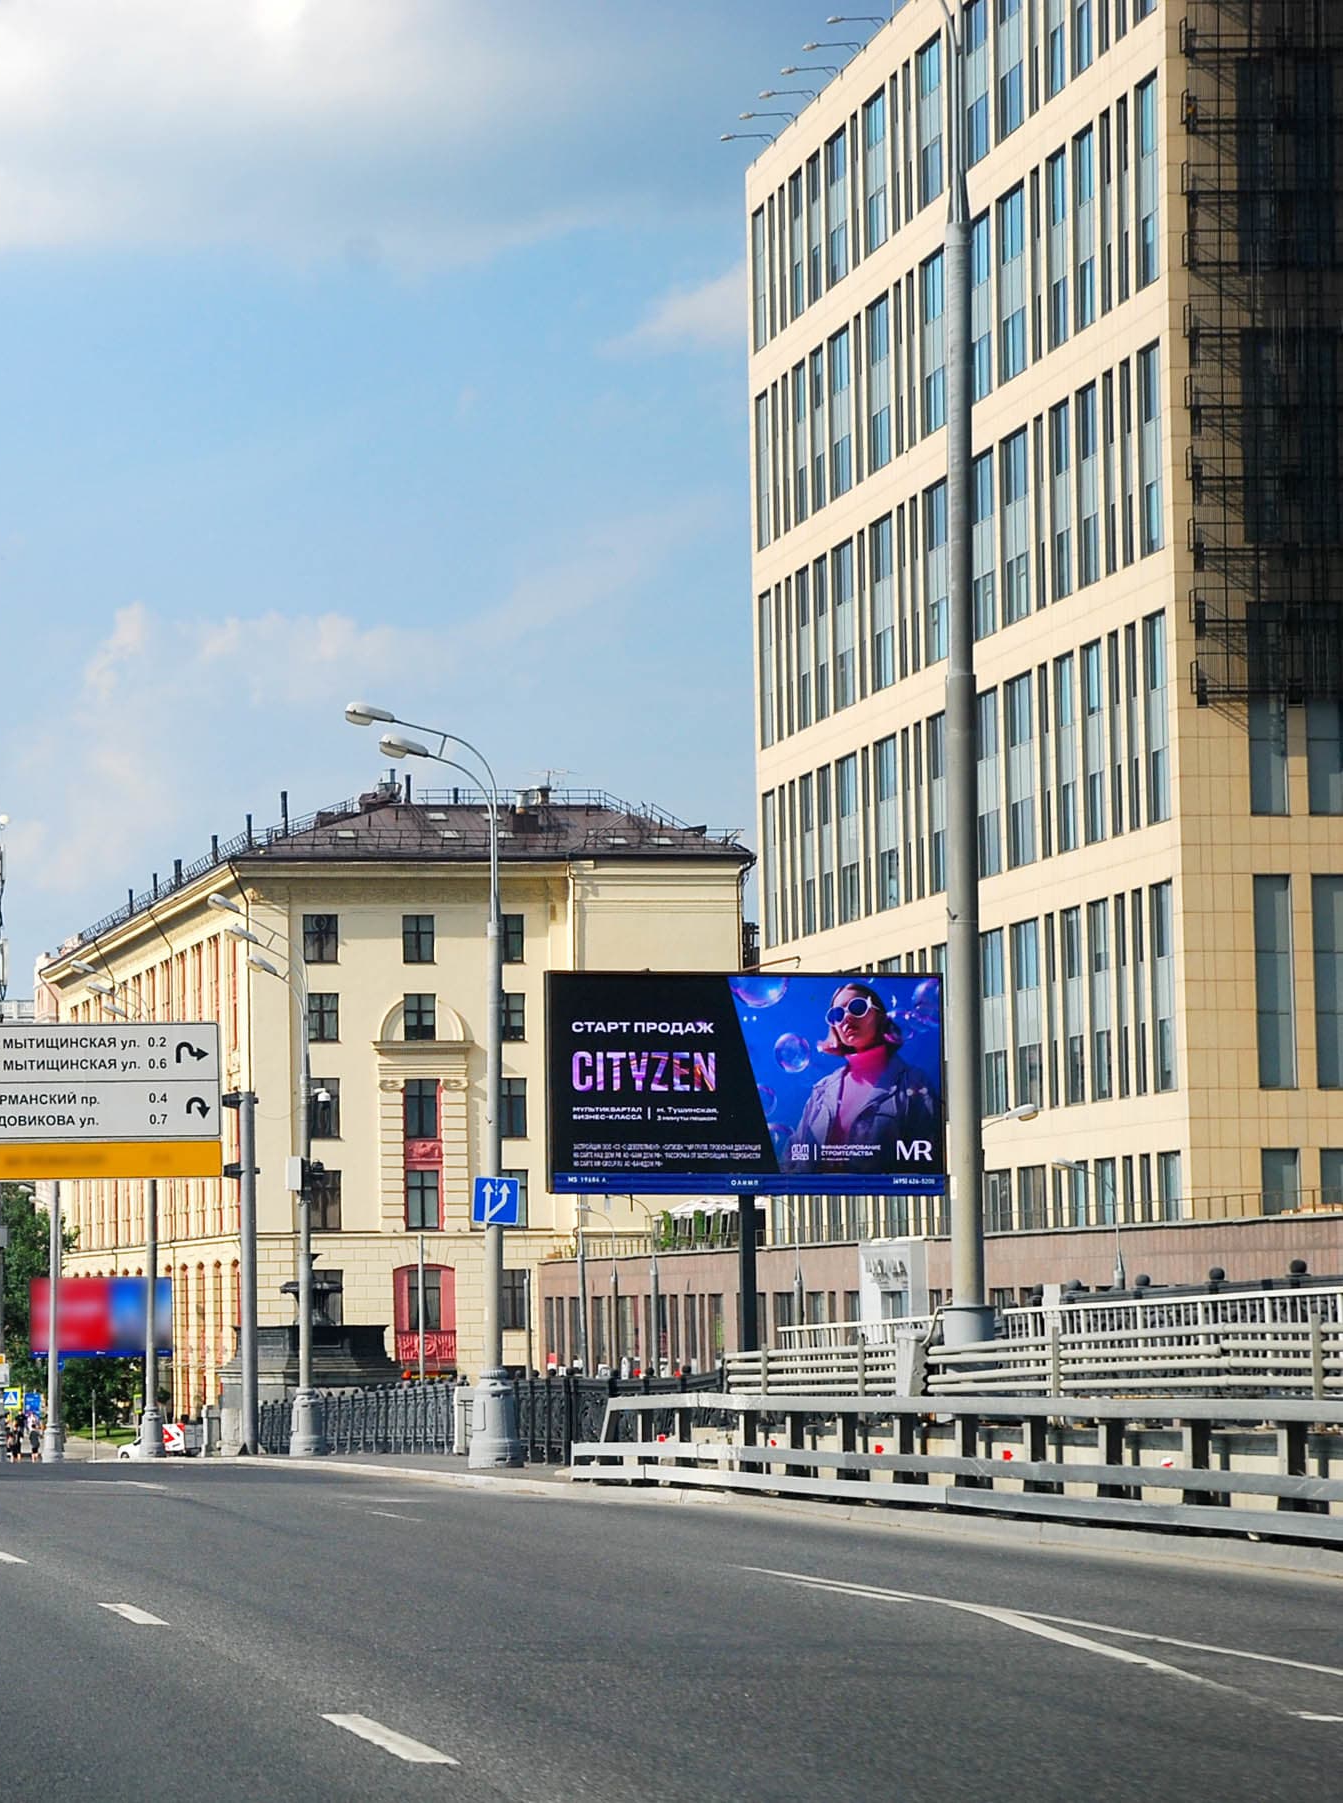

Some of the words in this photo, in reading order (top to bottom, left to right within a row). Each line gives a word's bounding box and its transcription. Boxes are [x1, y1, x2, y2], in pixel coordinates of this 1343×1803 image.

[571, 1021, 630, 1033] СТАРТ
[633, 1021, 714, 1035] ПРОДАЖ
[2, 1037, 117, 1051] МЫТИЩИНСКАЯ
[120, 1039, 140, 1051] ул.
[147, 1036, 167, 1048] 0.2
[2, 1058, 118, 1073] МЫТИЩИНСКАЯ
[121, 1061, 141, 1072] ул.
[148, 1058, 167, 1070] 0.6
[571, 1051, 717, 1092] CITYZEN
[80, 1096, 100, 1108] пр.
[148, 1092, 168, 1104] 0.4
[79, 1117, 99, 1129] ул.
[149, 1114, 168, 1125] 0.7
[572, 1113, 642, 1121] БИЗНЕС-КЛАССА
[896, 1140, 933, 1161] MR
